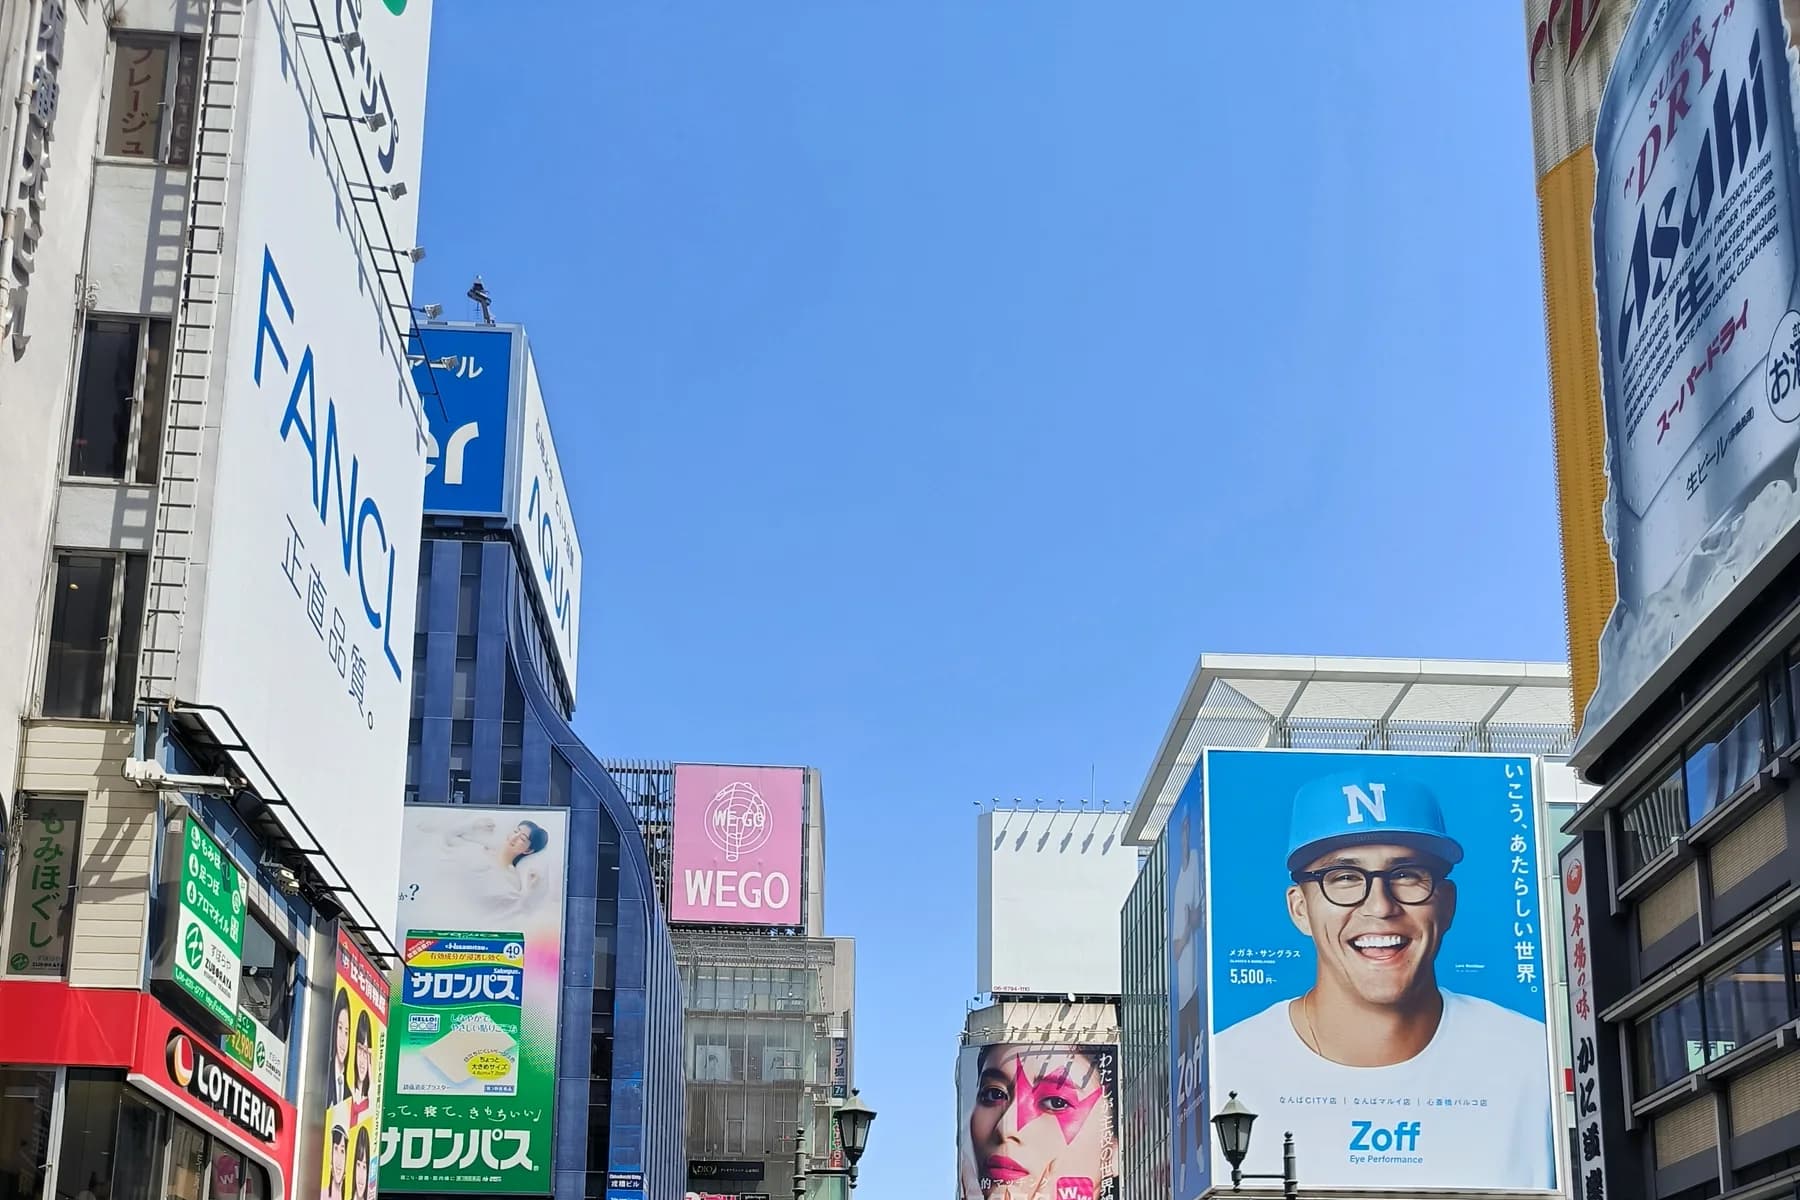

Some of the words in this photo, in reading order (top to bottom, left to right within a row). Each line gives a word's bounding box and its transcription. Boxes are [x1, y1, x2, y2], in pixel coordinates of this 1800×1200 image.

[1649, 15, 1702, 122] SUPER
[1618, 28, 1768, 364] Asahi
[1713, 177, 1747, 230] PRECISION
[1713, 208, 1739, 249] UNDER
[1739, 190, 1753, 215] THE
[1715, 219, 1746, 266] MASTER
[1716, 255, 1732, 284] ING
[1732, 203, 1777, 264] TECHNIQUES
[1674, 252, 1715, 342] 生
[1656, 298, 1749, 446] スーパードライ
[253, 242, 402, 683] FANCL
[281, 513, 374, 731] 正直品質。
[1342, 783, 1387, 824] N
[30, 809, 65, 949] もみほぐし
[684, 869, 790, 909] WEGO
[1504, 763, 1538, 994] いこう、あたらしい世界。
[204, 957, 233, 991] ZUBORAYA
[506, 945, 521, 956] 40
[411, 972, 517, 1000] サロンパス
[197, 1053, 276, 1143] LOTTERIA
[1349, 1120, 1421, 1152] Zoff
[1350, 1154, 1366, 1165] Eye
[1367, 1154, 1424, 1165] Performance
